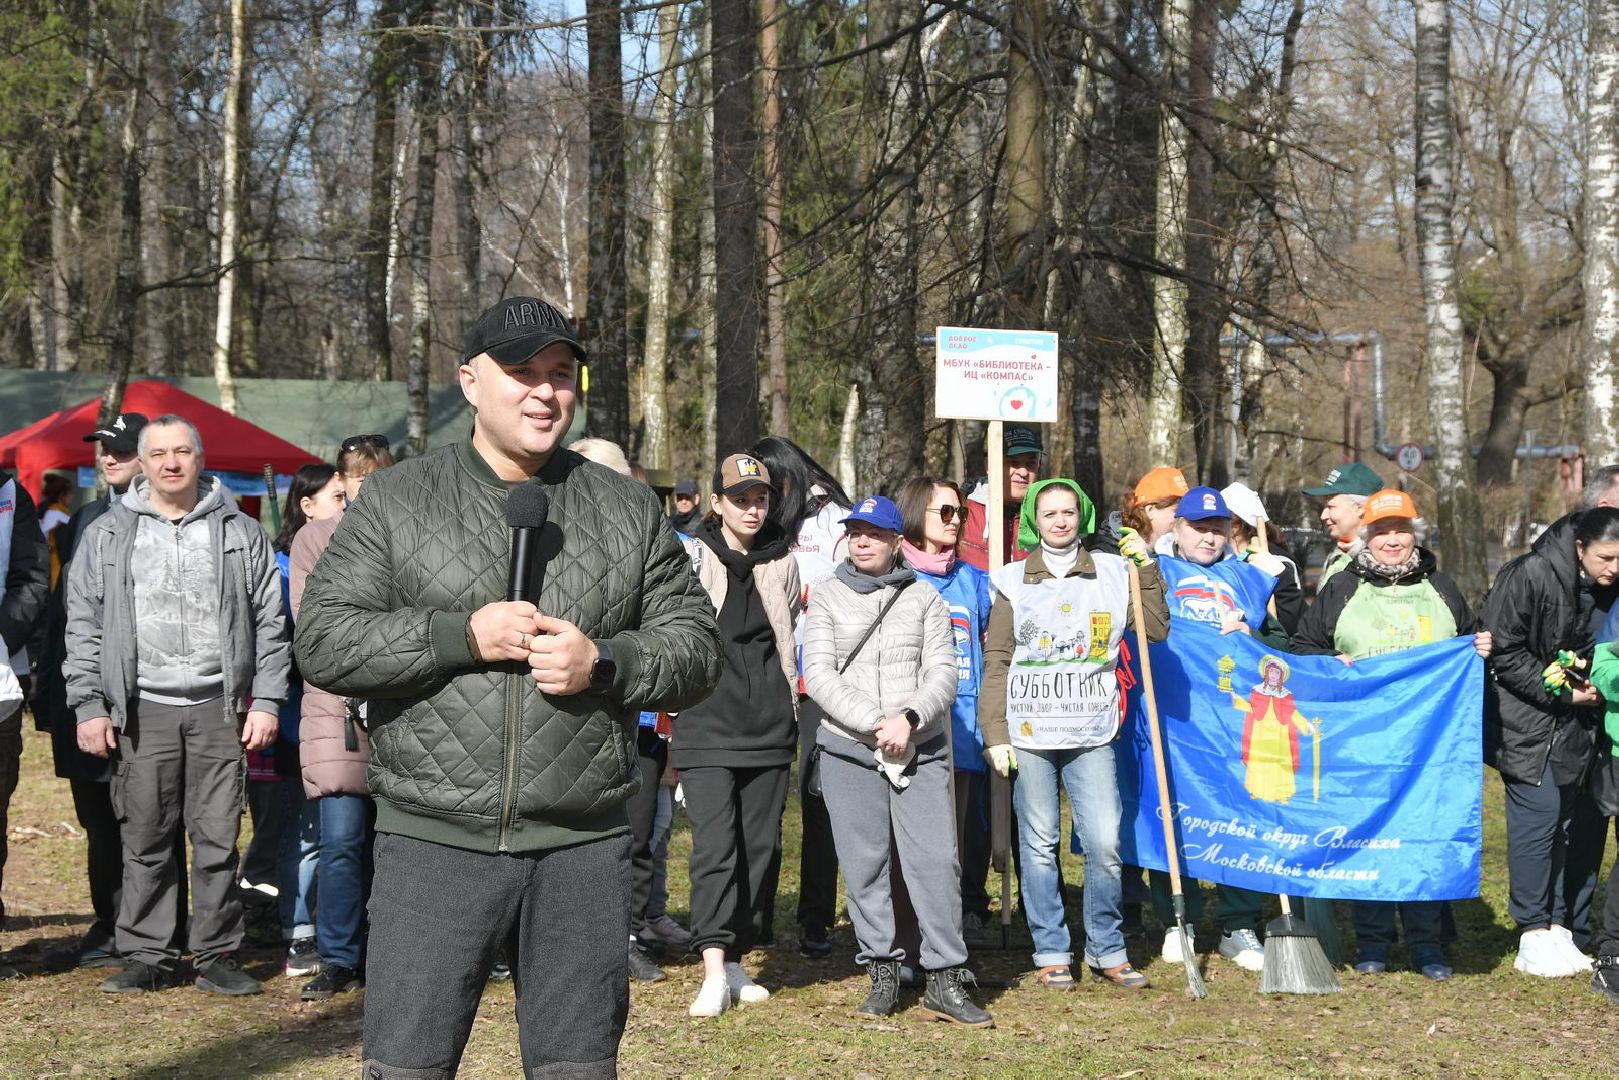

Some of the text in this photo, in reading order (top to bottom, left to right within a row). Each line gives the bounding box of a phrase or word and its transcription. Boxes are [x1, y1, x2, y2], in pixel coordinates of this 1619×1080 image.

[943, 359, 971, 368] МБУК
[973, 360, 1044, 371] «БИБЛИОТЕКА
[964, 370, 1034, 381] ИЦ «КОМПАС»
[1010, 672, 1107, 699] СУББОТНИК
[1060, 702, 1084, 713] ЧИСТАЯ
[1156, 802, 1401, 849] Городской округ Власиха
[1180, 843, 1380, 881] Московской области
